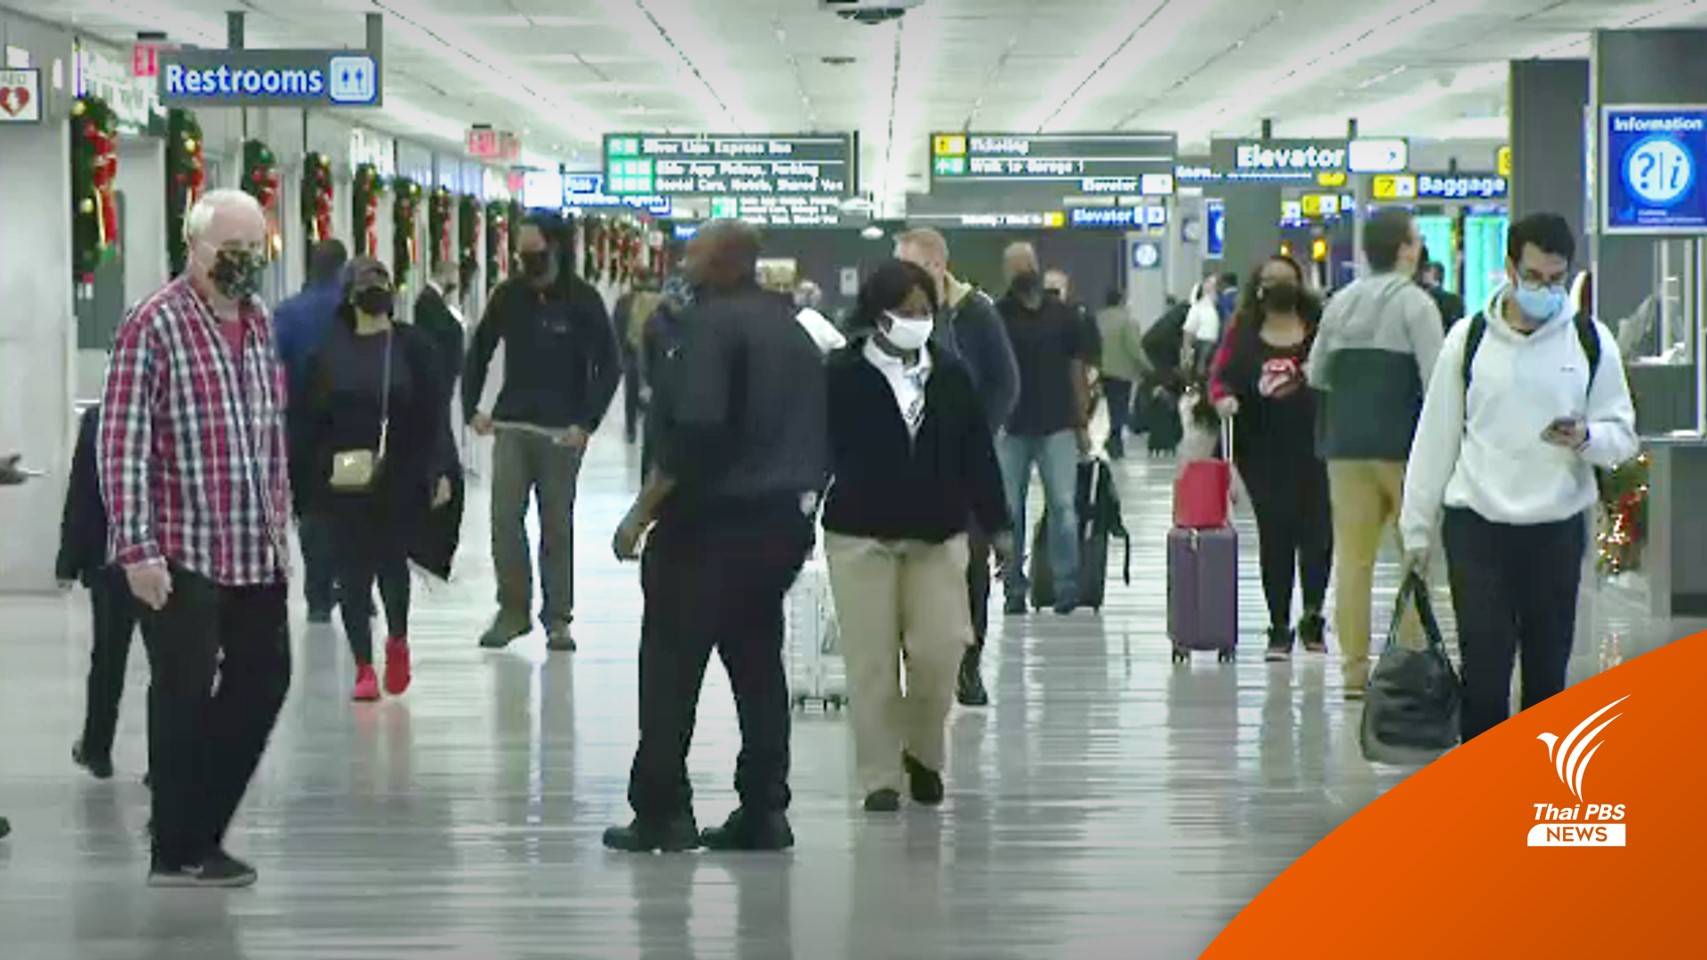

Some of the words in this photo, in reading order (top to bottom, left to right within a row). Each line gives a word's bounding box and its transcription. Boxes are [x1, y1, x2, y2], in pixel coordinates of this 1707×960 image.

[166, 64, 322, 92] Restrooms
[1614, 116, 1702, 131] Information
[1237, 144, 1345, 167] Elevator
[1082, 178, 1137, 191] Elevator
[1420, 175, 1506, 197] Baggage
[1073, 208, 1132, 222] Elevator
